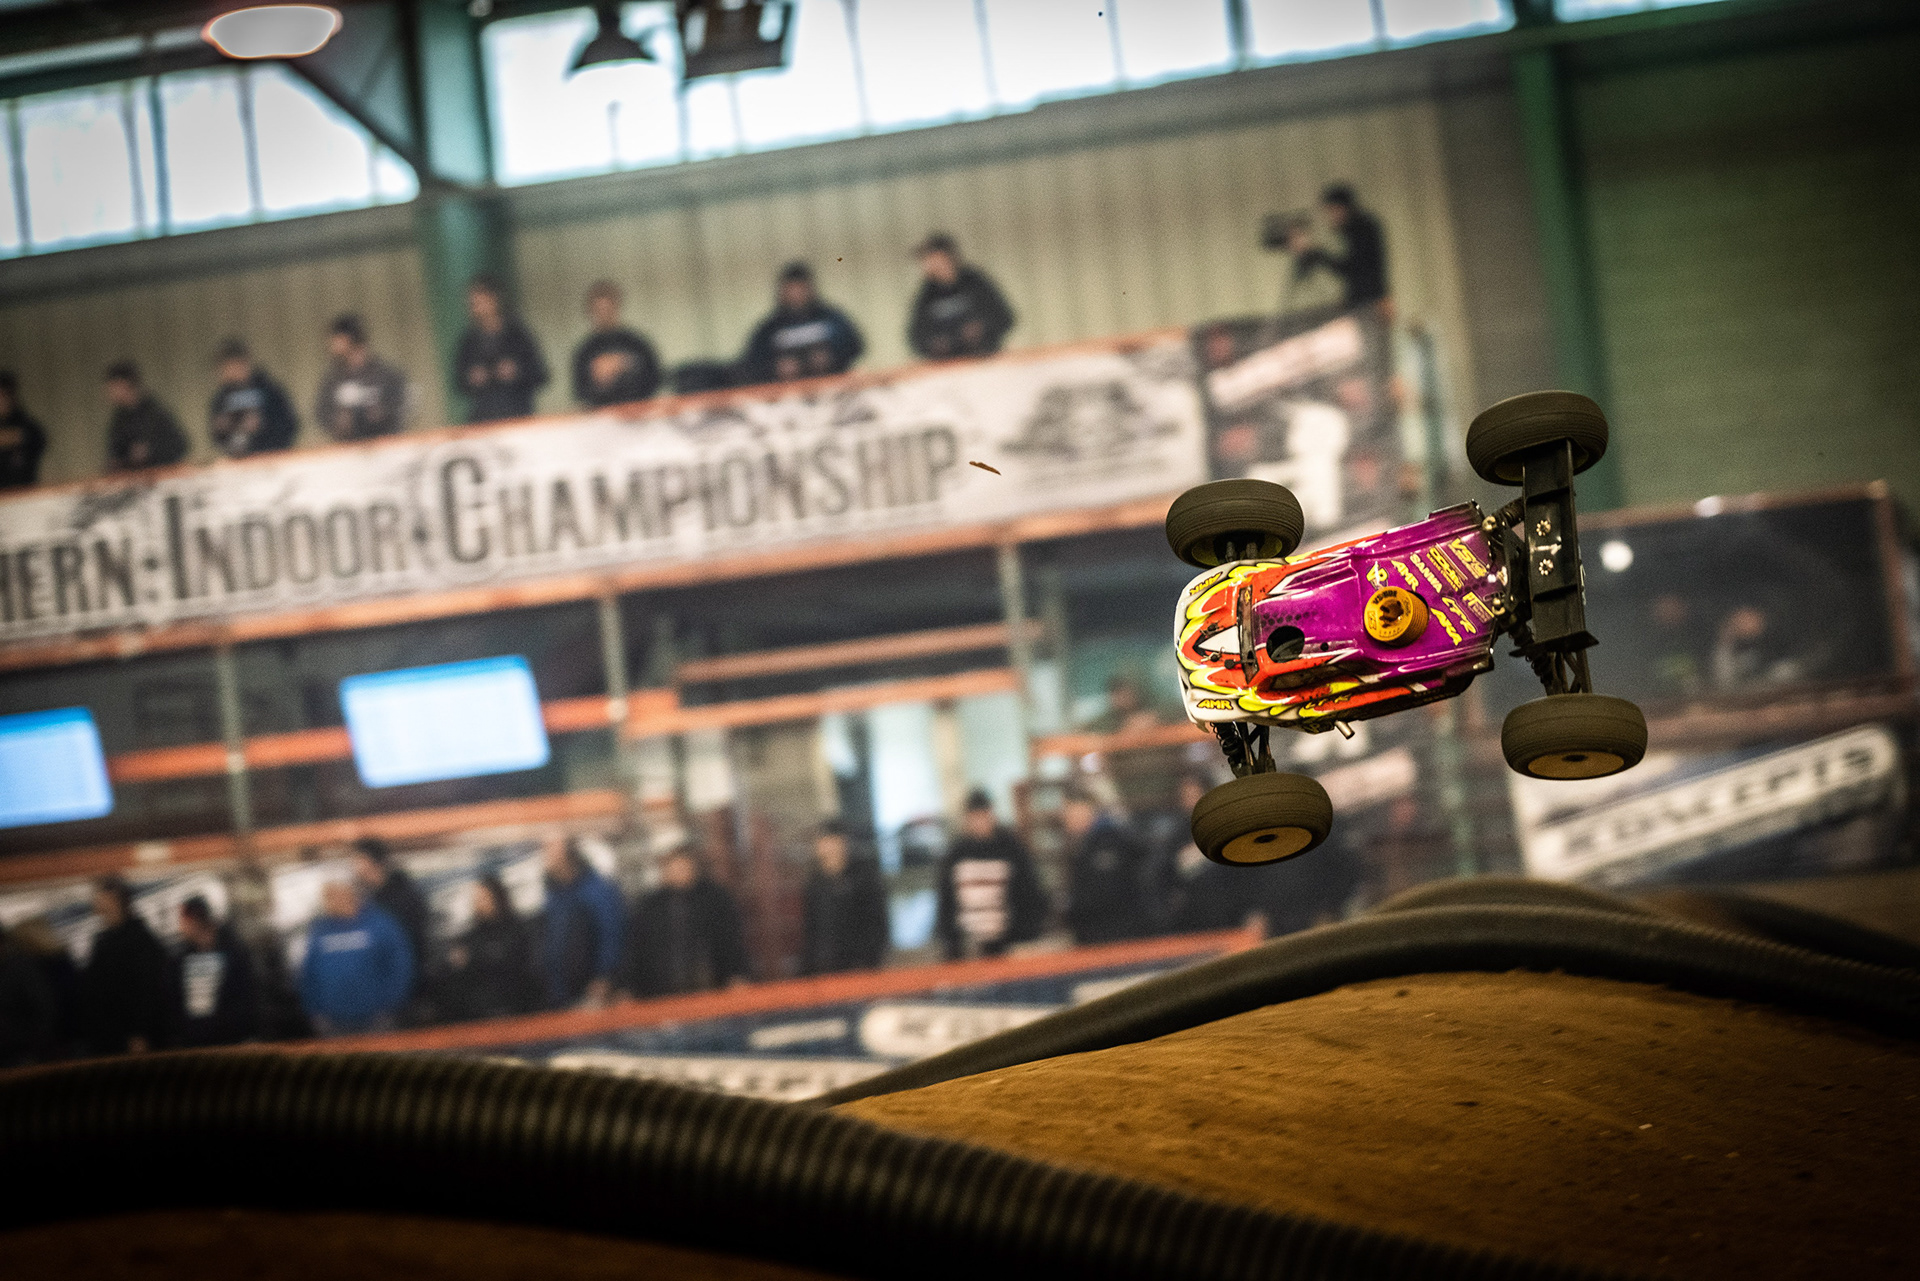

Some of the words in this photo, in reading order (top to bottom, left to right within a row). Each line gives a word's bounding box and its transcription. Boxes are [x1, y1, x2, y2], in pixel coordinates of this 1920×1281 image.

[163, 494, 406, 600] INDOOR
[439, 426, 957, 565] CHAMPIONSHIP
[1391, 560, 1419, 591] AMR
[1409, 553, 1442, 593] SANWA
[1430, 608, 1462, 645] AKA
[1196, 698, 1233, 710] AMR
